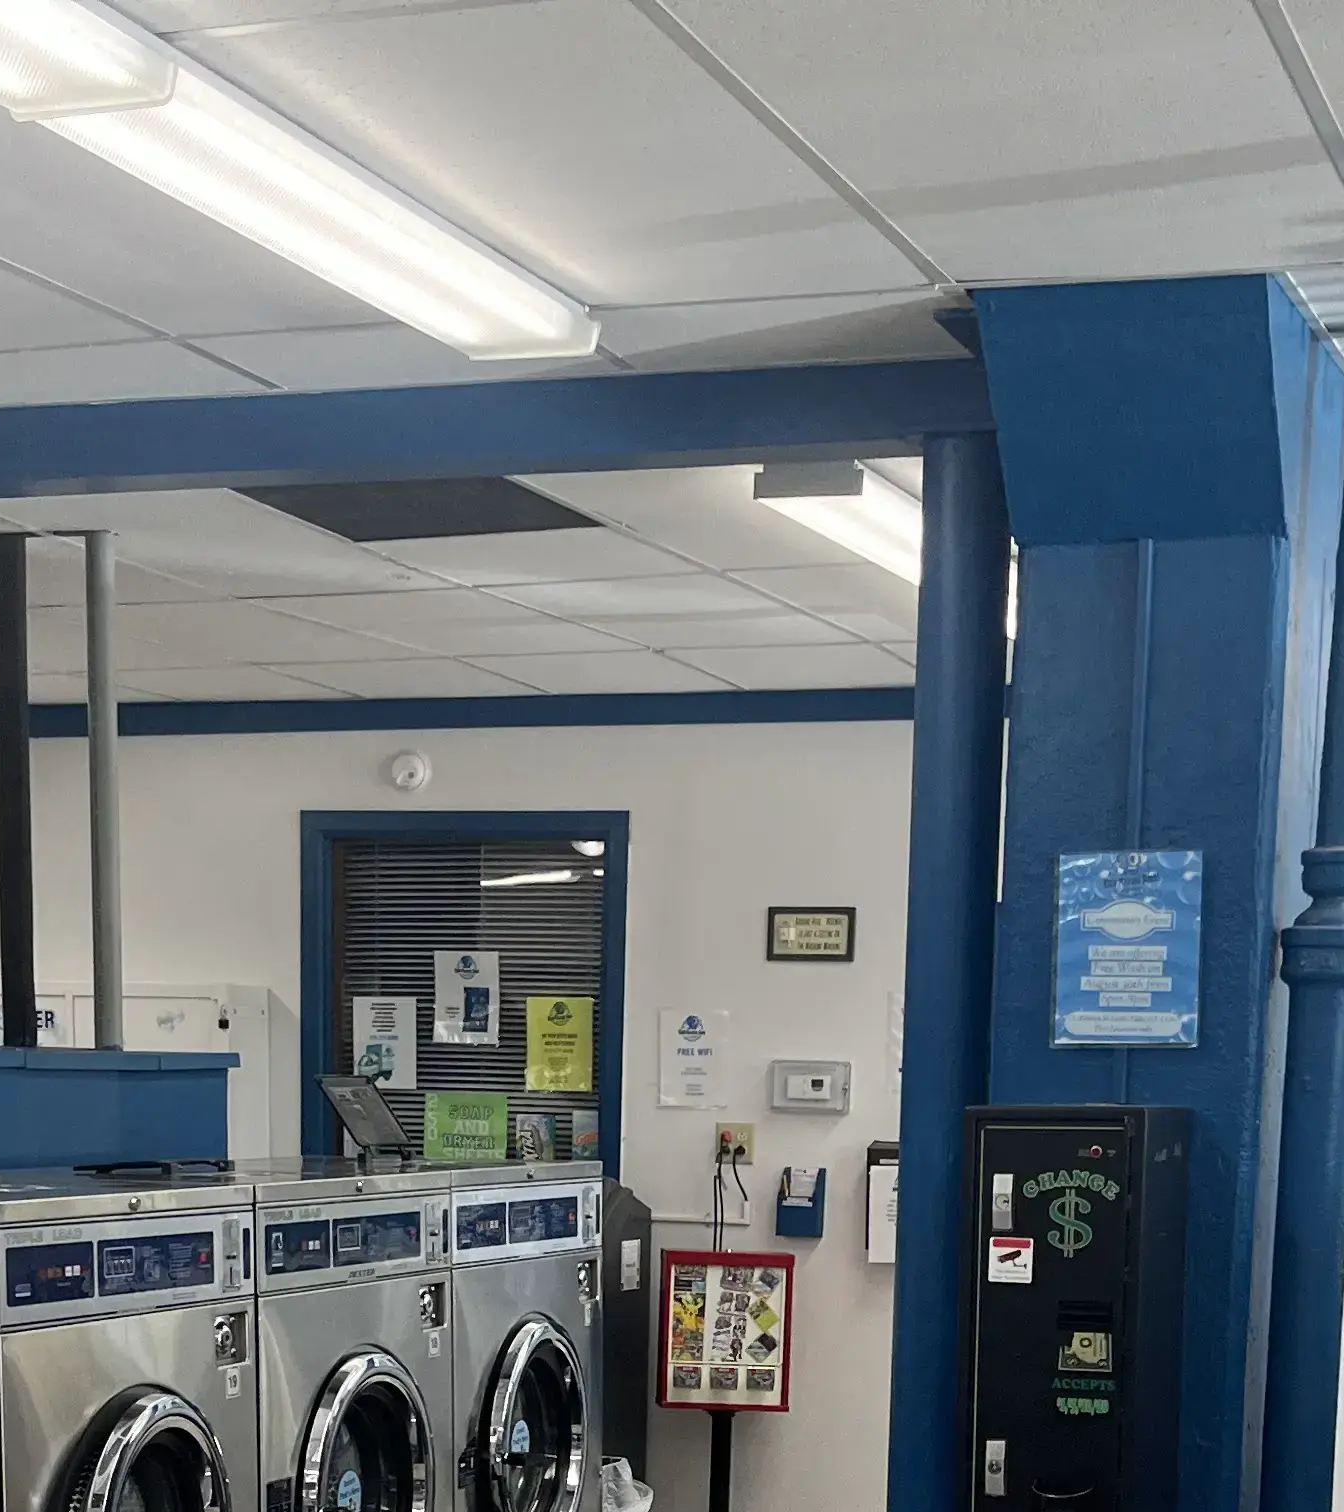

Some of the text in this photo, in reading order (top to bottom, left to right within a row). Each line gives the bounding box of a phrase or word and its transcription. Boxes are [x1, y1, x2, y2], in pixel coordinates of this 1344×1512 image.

[448, 1105, 494, 1120] SOAP
[453, 1120, 489, 1136] AND
[443, 1134, 495, 1150] DRYER
[1022, 1170, 1121, 1201] CHANGE
[1051, 1377, 1116, 1392] ACCEPTS
